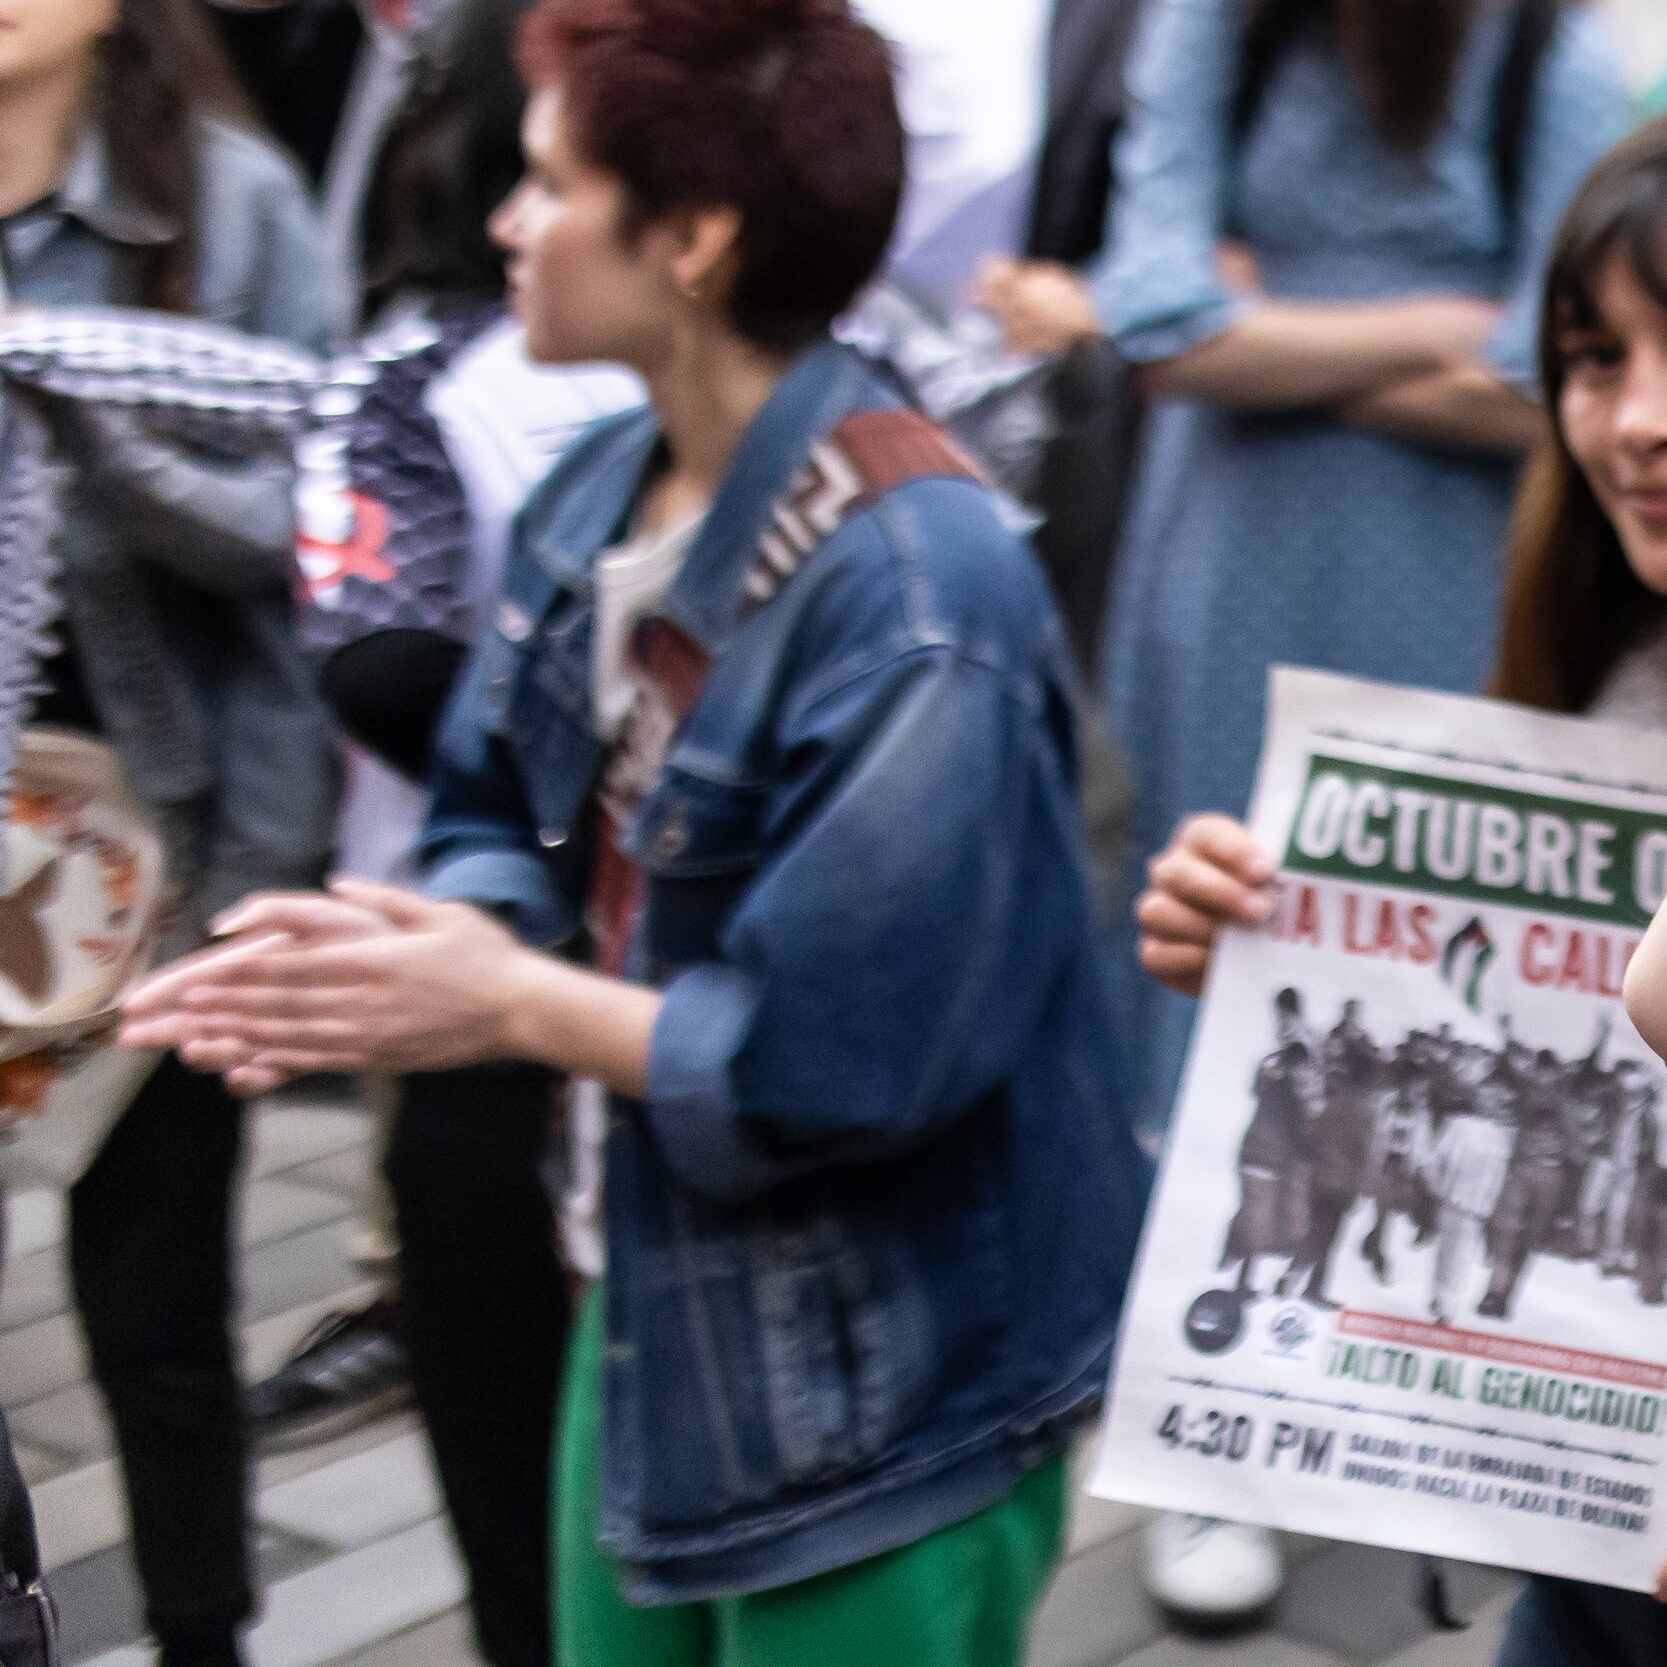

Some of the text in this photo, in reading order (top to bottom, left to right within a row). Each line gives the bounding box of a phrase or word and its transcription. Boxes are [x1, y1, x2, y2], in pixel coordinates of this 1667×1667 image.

[1294, 770, 1617, 906] OCTUBRE
[1340, 890, 1440, 968] LAS
[1428, 1355, 1466, 1400] AL
[1156, 1402, 1337, 1479] 4:30 PM
